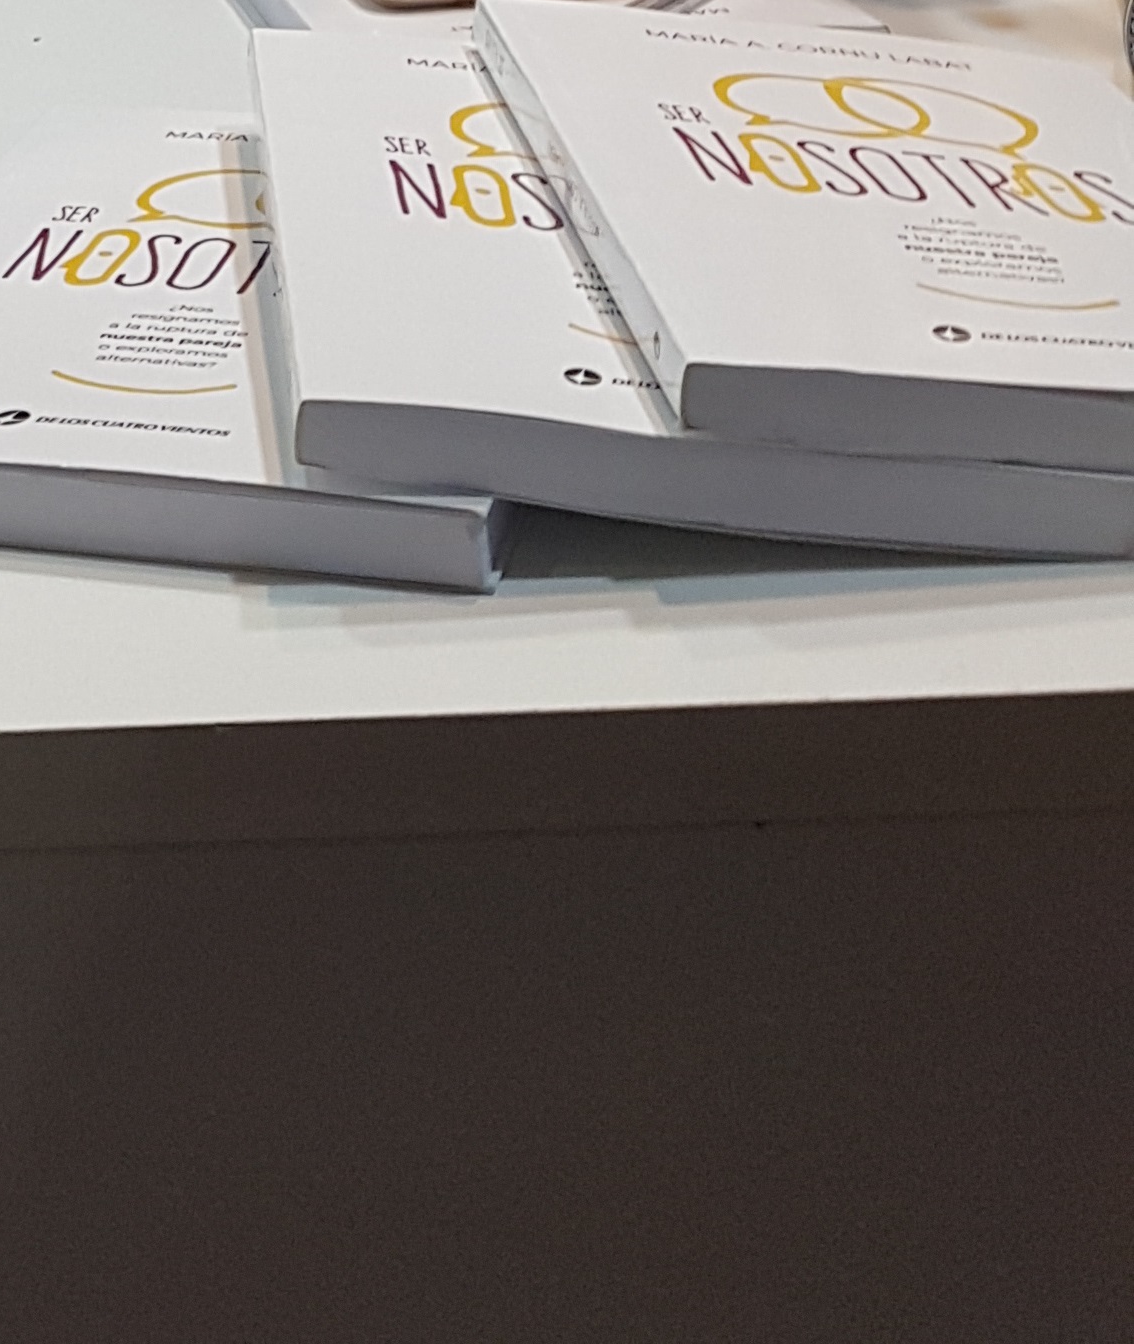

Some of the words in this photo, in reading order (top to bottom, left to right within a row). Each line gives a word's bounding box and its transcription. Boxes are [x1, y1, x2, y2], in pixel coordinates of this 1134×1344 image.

[656, 101, 712, 126] SER
[383, 135, 432, 158] SER
[52, 205, 100, 223] SER
[1, 227, 272, 295] NOSOT
[131, 313, 241, 326] resignamos
[125, 322, 141, 330] la
[146, 324, 218, 336] ruptura
[223, 329, 250, 338] de
[100, 332, 174, 343] nuestra
[179, 337, 243, 349] pareja
[115, 344, 229, 358] exploramos
[92, 419, 159, 431] CUATRO
[160, 424, 232, 437] VIENTOS
